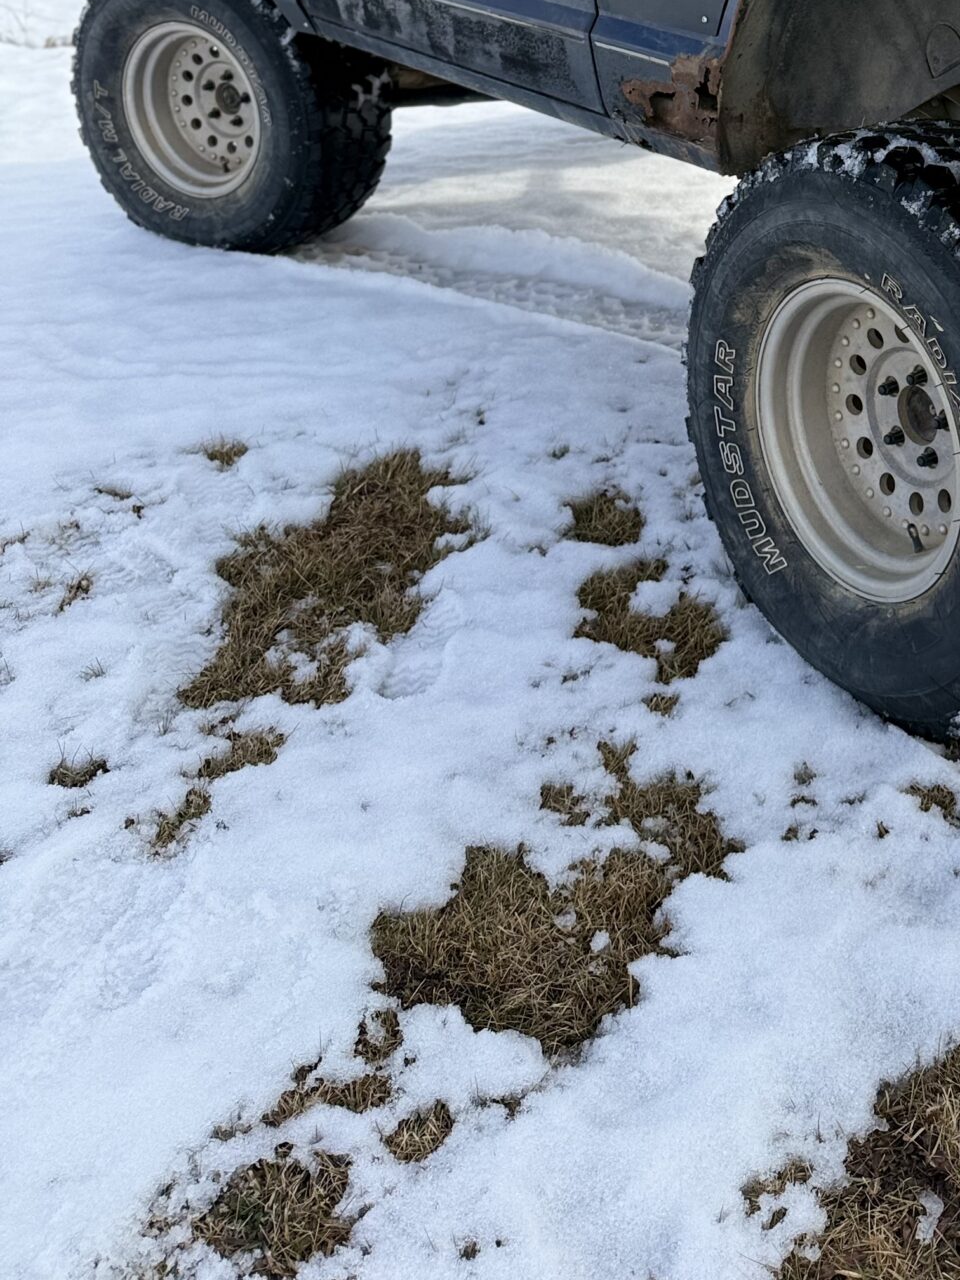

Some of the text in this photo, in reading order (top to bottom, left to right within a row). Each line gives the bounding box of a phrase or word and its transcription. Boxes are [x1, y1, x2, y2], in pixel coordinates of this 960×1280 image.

[93, 79, 190, 221] RADIAL M/T
[714, 338, 788, 576] MUDSTAR
